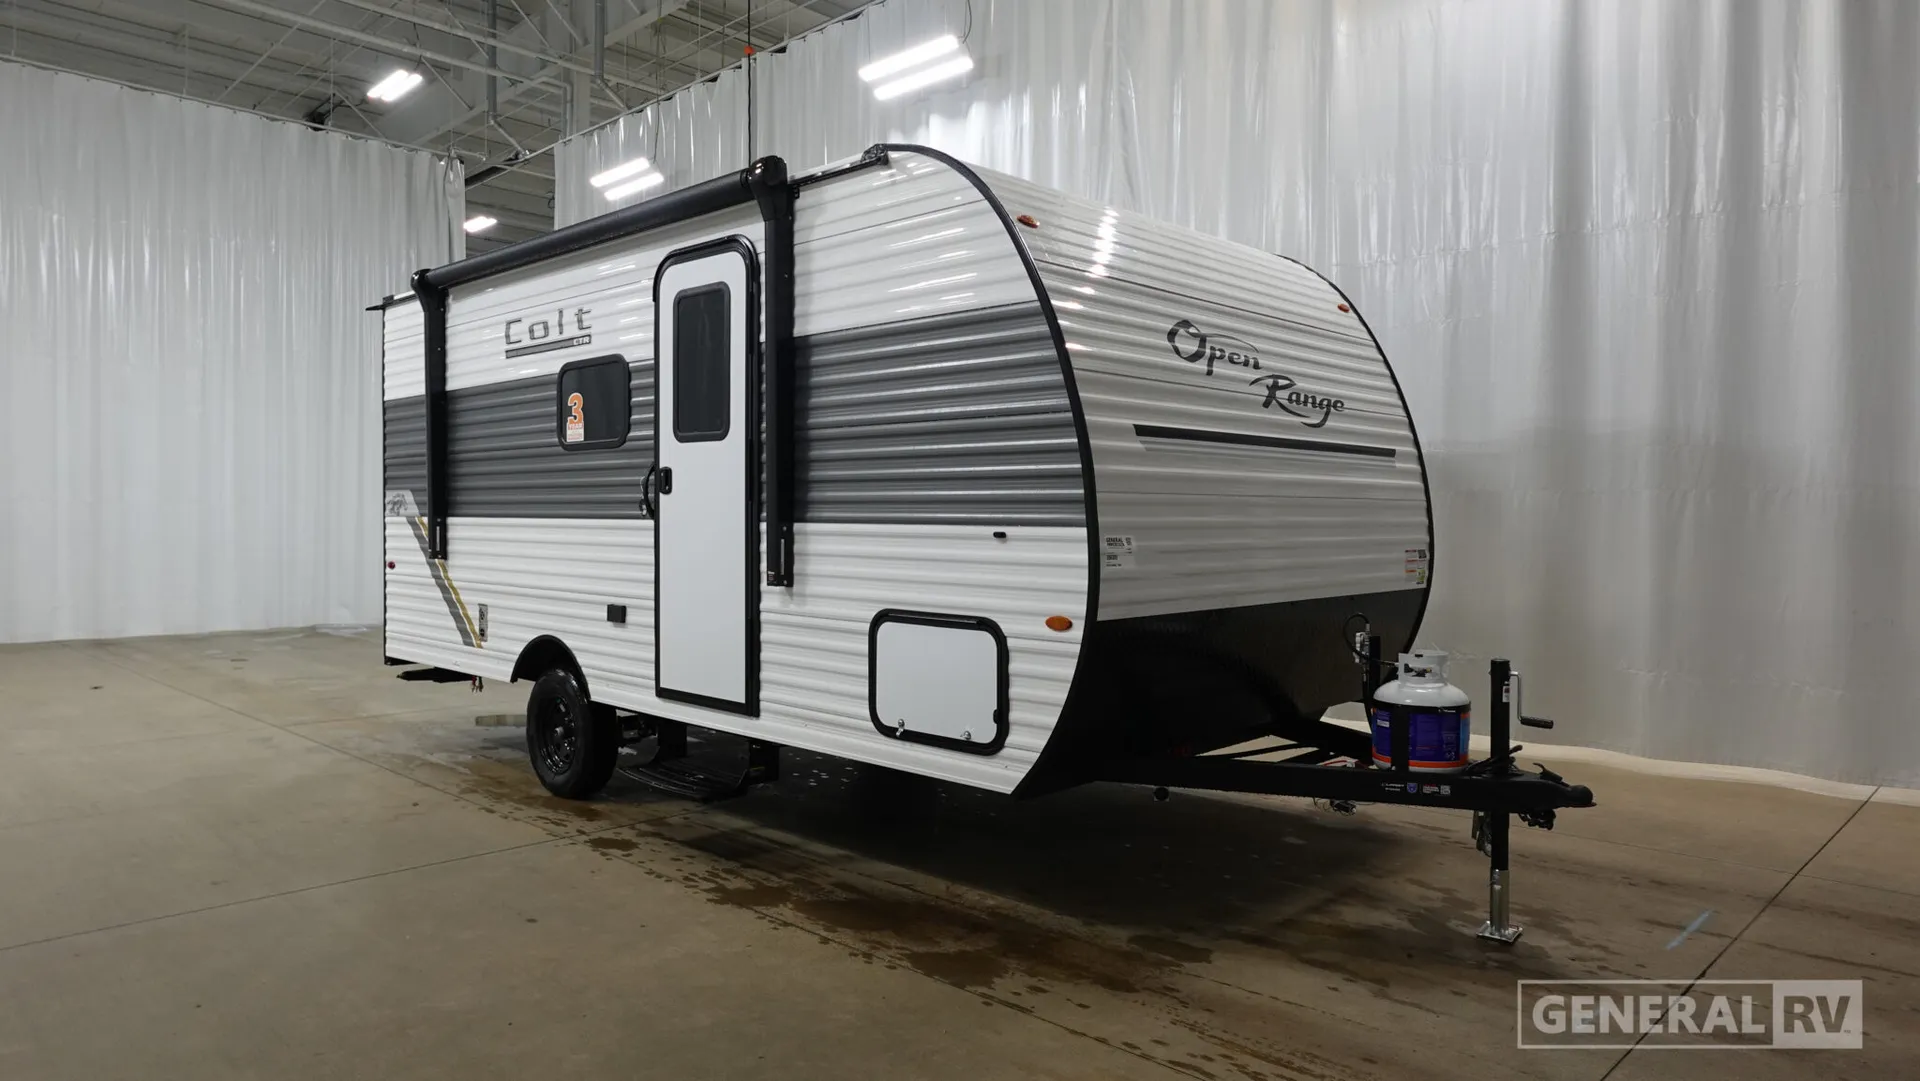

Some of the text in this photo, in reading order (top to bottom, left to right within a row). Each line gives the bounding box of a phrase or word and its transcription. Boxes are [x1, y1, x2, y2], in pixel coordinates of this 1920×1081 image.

[505, 308, 592, 345] Colt
[1167, 319, 1264, 376] Open
[568, 392, 583, 424] 3
[1249, 374, 1345, 429] Range
